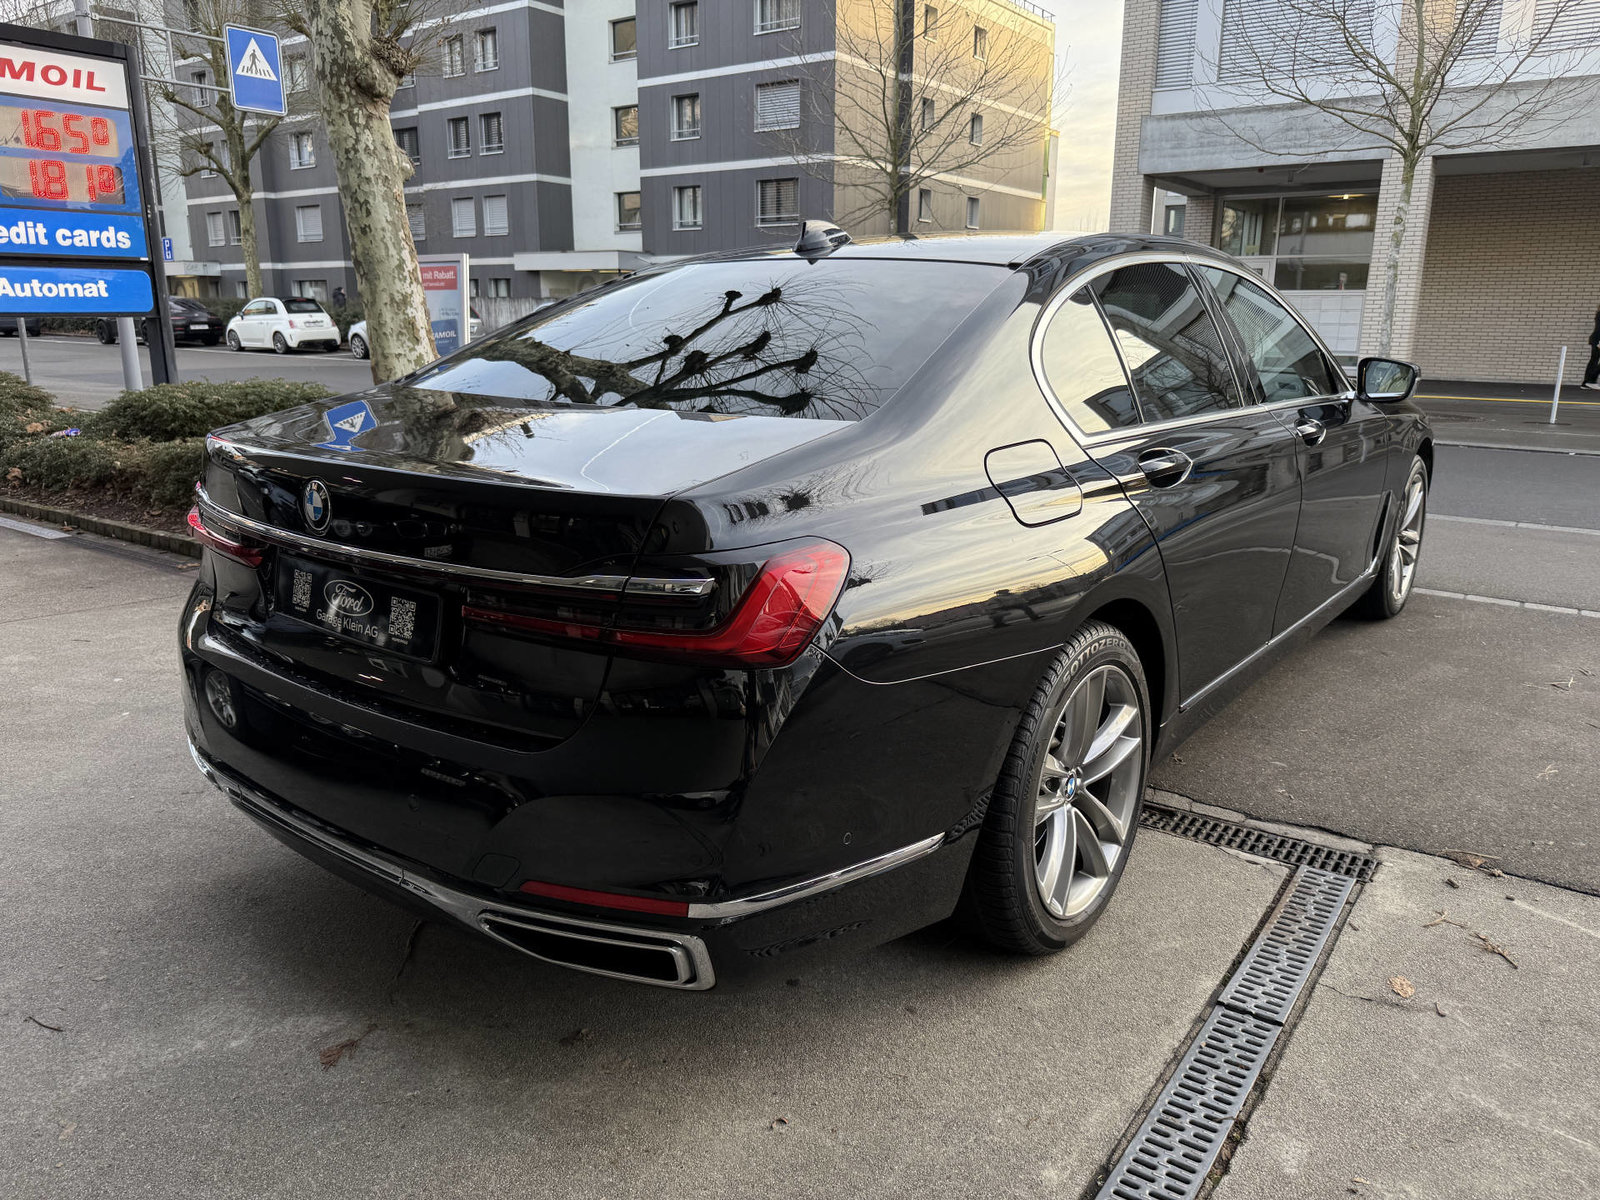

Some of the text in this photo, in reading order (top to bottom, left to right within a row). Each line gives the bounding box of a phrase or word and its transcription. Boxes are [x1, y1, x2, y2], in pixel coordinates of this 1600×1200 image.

[0, 57, 106, 92] MOIL
[0, 221, 132, 249] edit cards
[0, 277, 109, 298] Automat
[422, 271, 433, 280] mit
[331, 583, 365, 612] Ford
[316, 608, 379, 638] Garage Klein AG
[1063, 638, 1127, 683] SOTTOZERO
